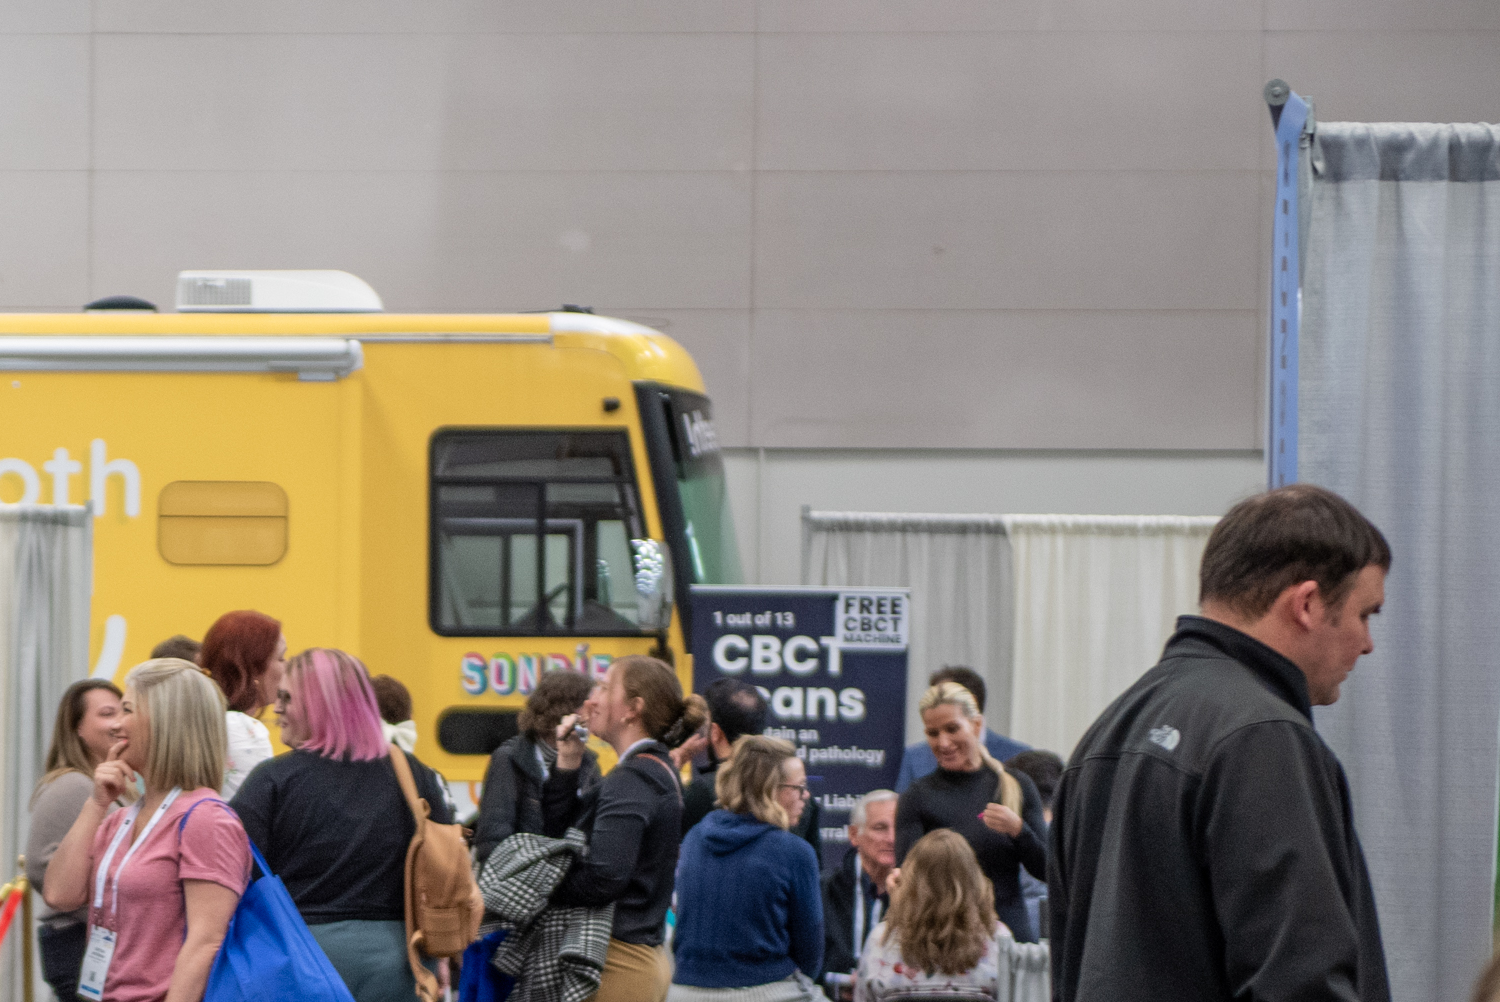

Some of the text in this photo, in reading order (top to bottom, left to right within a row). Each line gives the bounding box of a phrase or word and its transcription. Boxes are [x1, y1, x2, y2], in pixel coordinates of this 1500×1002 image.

[844, 595, 903, 615] FREE
[713, 610, 795, 627] 1 out of 13
[843, 616, 903, 632] CBCT
[843, 633, 903, 643] MACHINE
[712, 633, 842, 676] CBCT
[754, 685, 866, 721] ans
[798, 728, 819, 742] an
[808, 745, 886, 766] pathology
